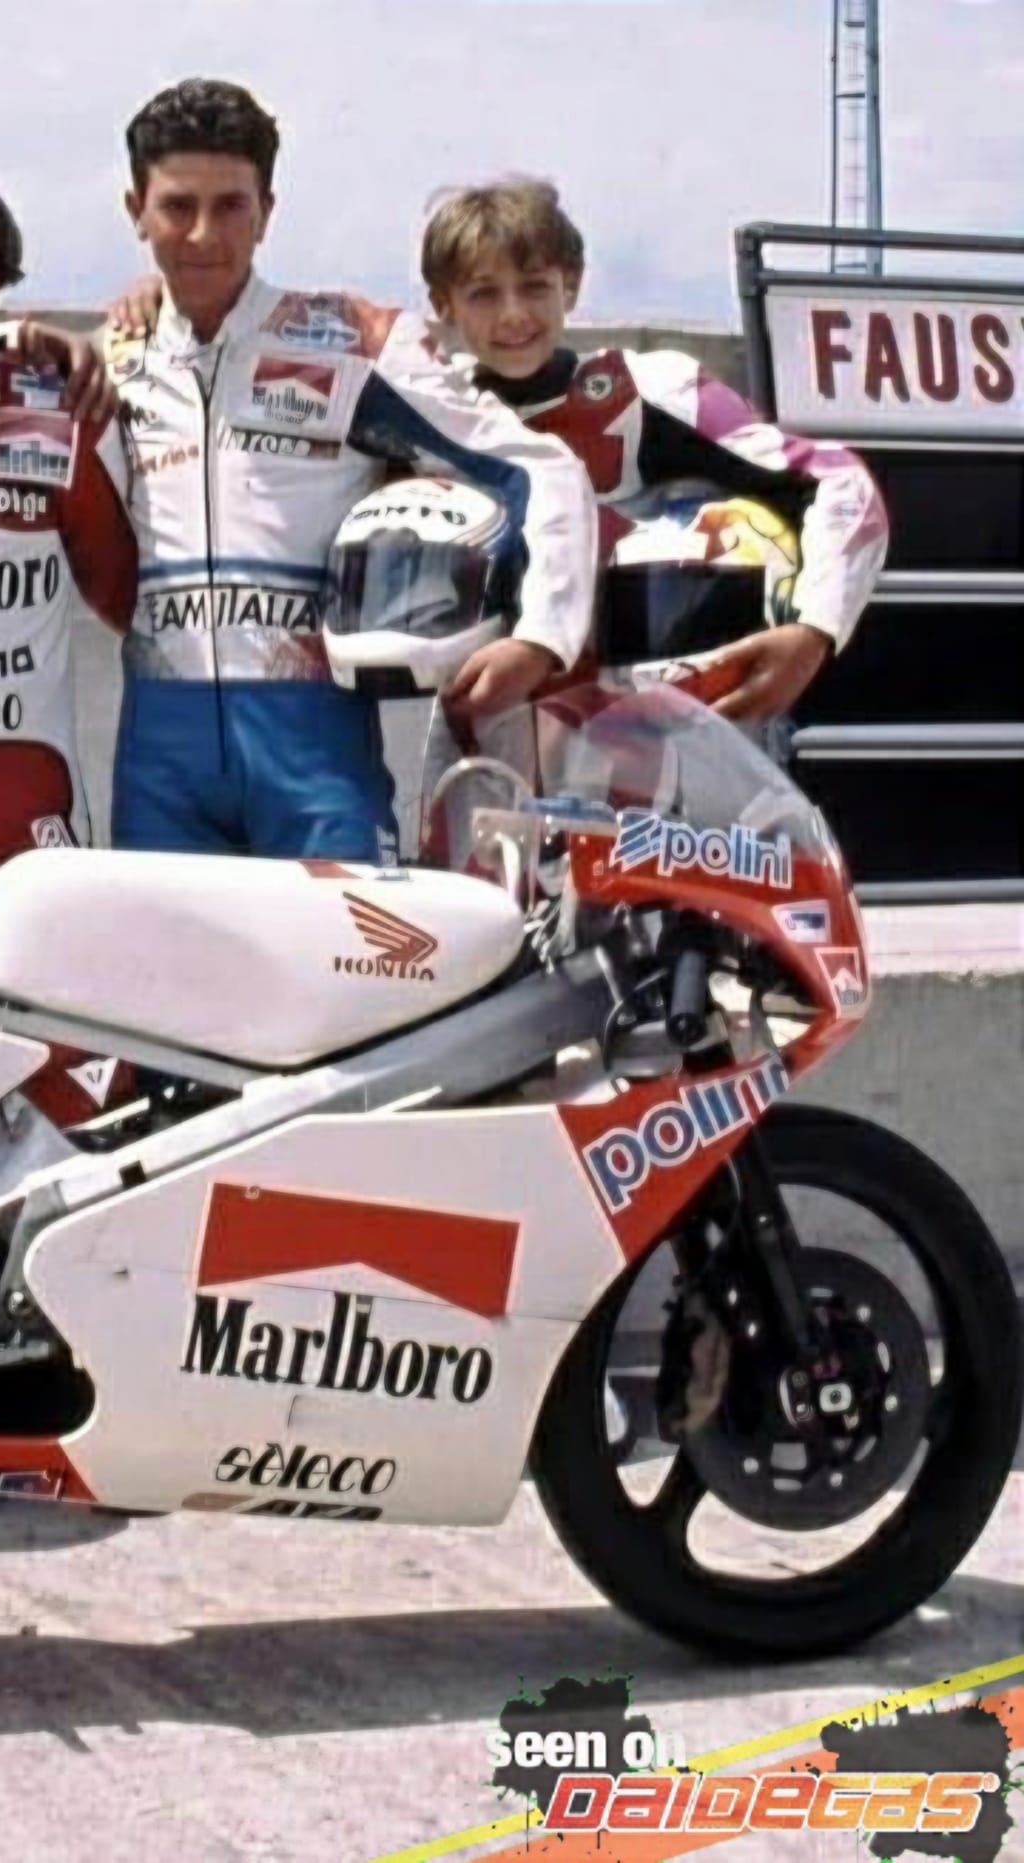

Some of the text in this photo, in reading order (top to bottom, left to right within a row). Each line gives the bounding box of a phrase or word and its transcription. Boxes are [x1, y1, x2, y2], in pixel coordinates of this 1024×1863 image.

[811, 310, 1024, 403] FAUS
[657, 813, 793, 890] polini
[334, 956, 435, 981] HONDA
[180, 1290, 494, 1404] Marlboro
